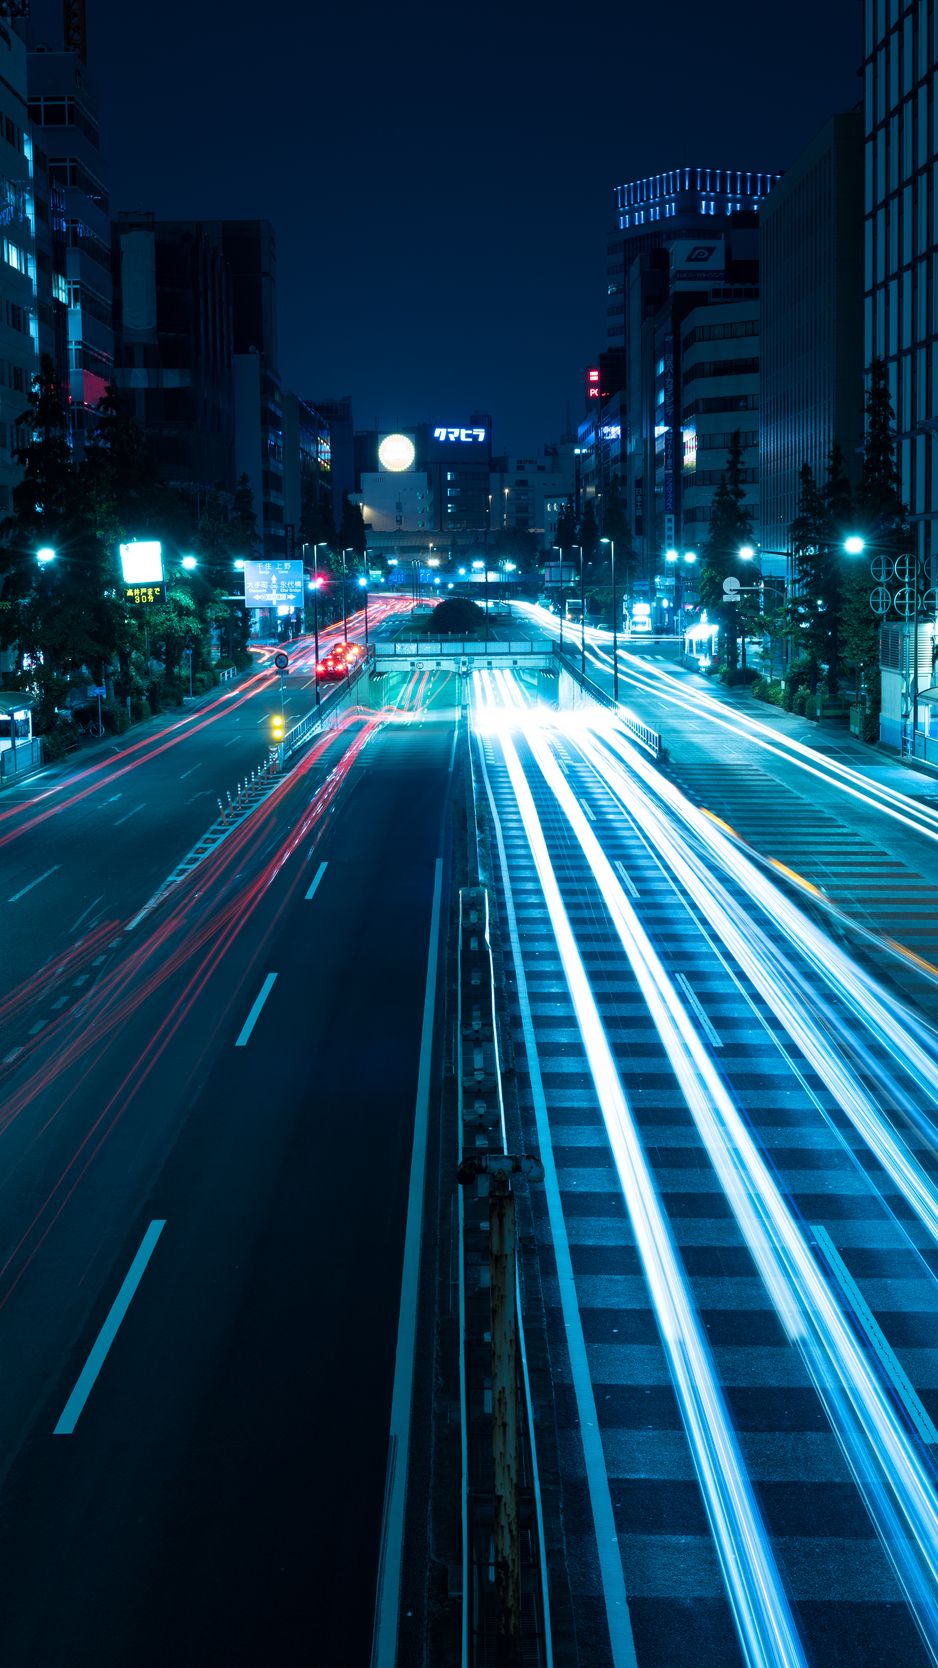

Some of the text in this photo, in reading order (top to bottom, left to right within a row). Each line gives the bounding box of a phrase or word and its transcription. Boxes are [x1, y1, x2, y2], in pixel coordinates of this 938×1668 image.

[434, 428, 485, 441] クマヒラ
[275, 562, 291, 570] 上野
[134, 594, 154, 603] 30分
